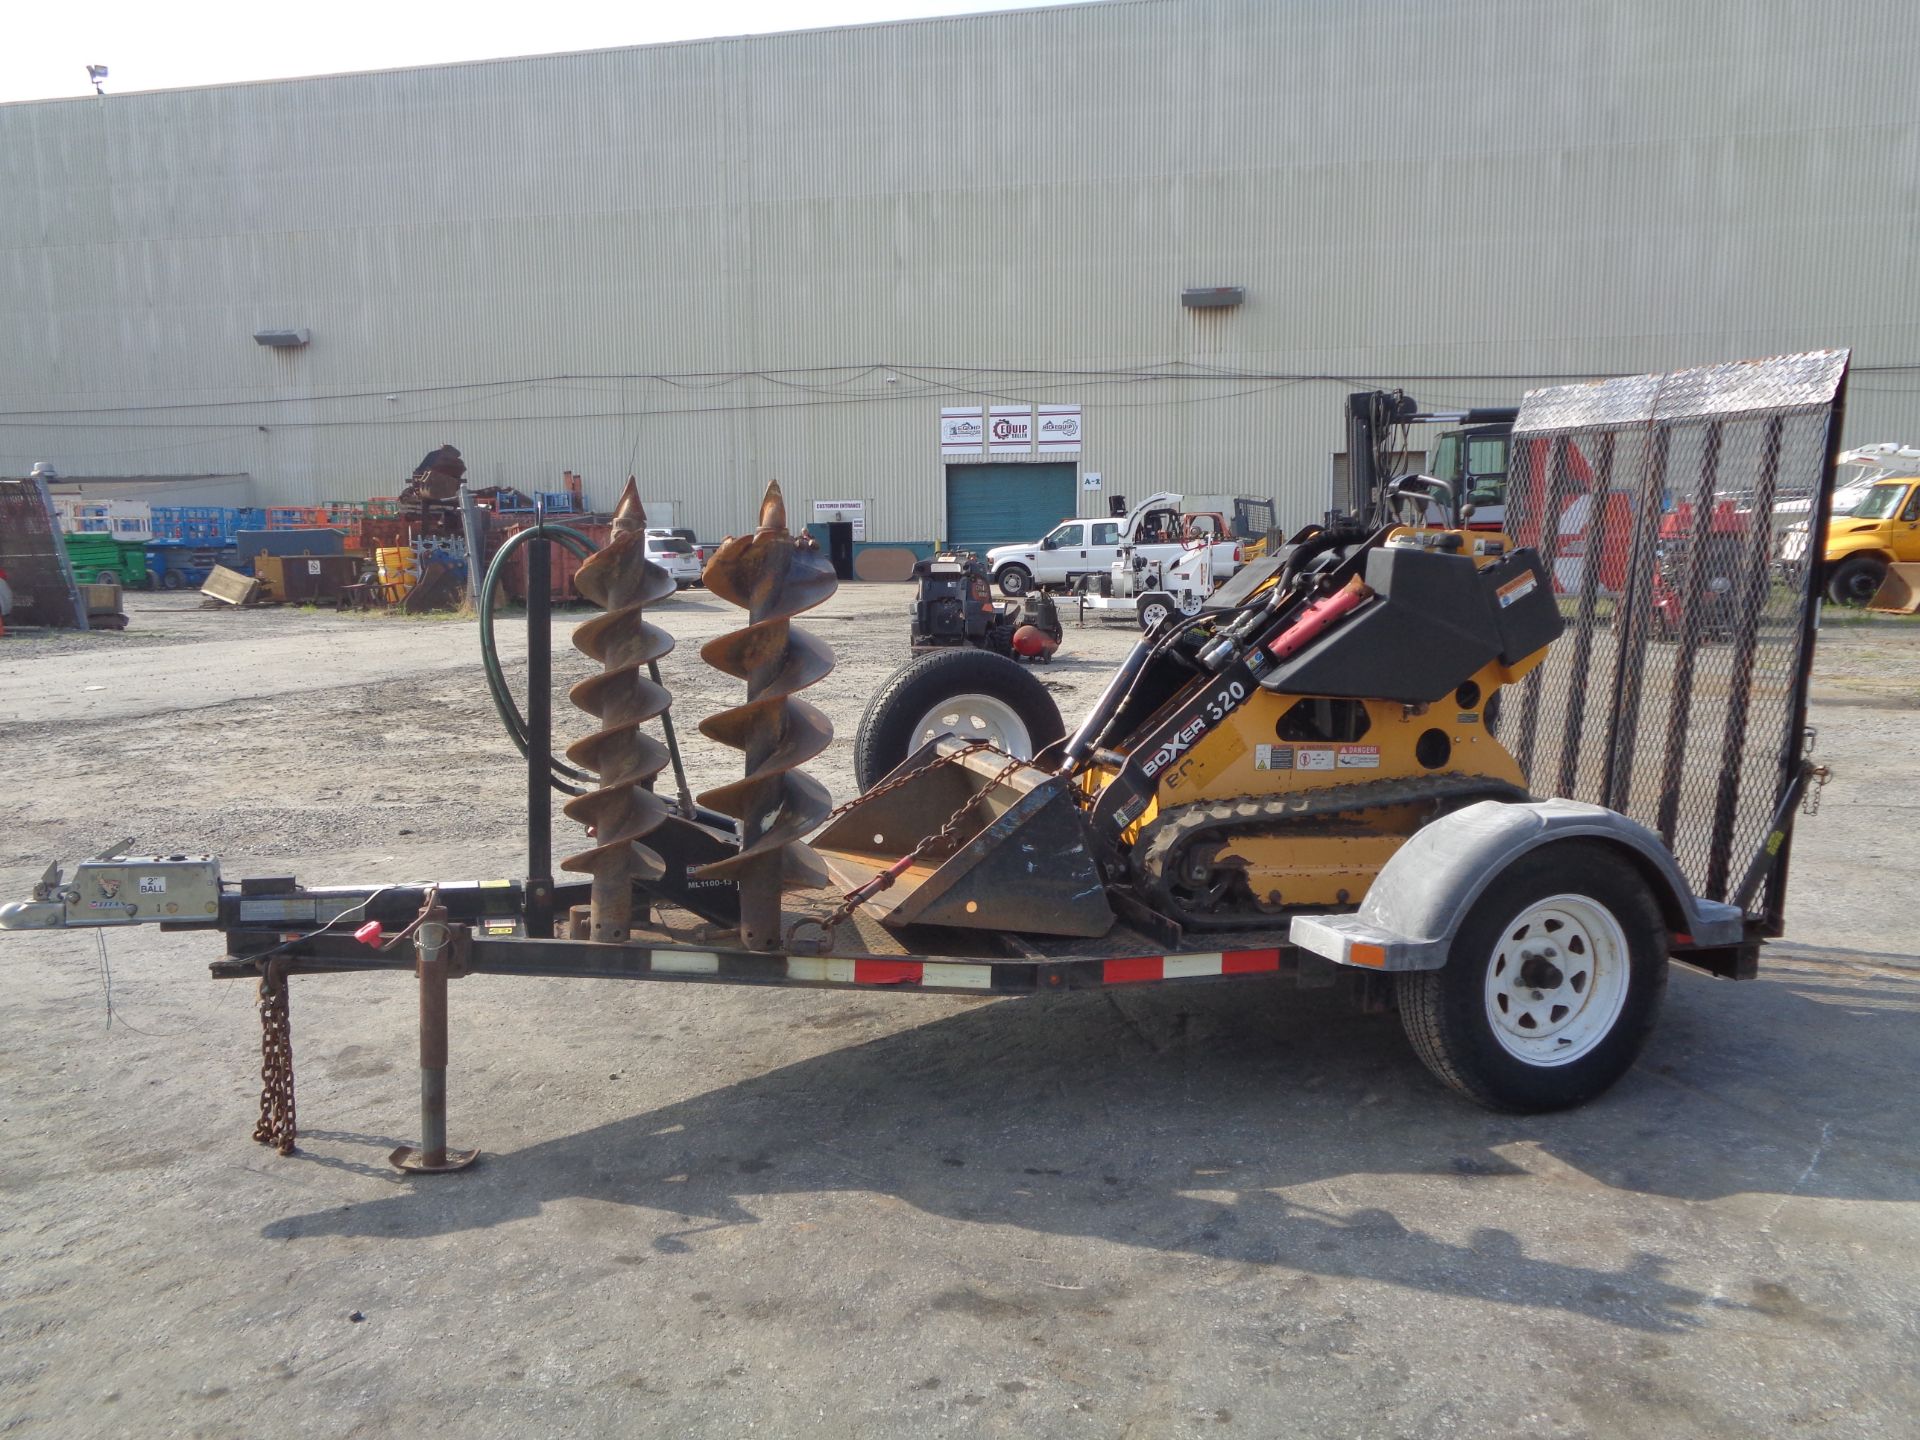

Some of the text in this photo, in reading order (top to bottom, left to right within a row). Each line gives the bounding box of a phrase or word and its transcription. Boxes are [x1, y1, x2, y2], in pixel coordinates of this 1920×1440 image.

[1000, 424, 1028, 434] EQUIP
[1142, 717, 1206, 778] BOXER
[1206, 681, 1245, 720] 320
[1348, 746, 1377, 754] DANGER!
[147, 877, 158, 885] 2"
[141, 885, 164, 893] BALL
